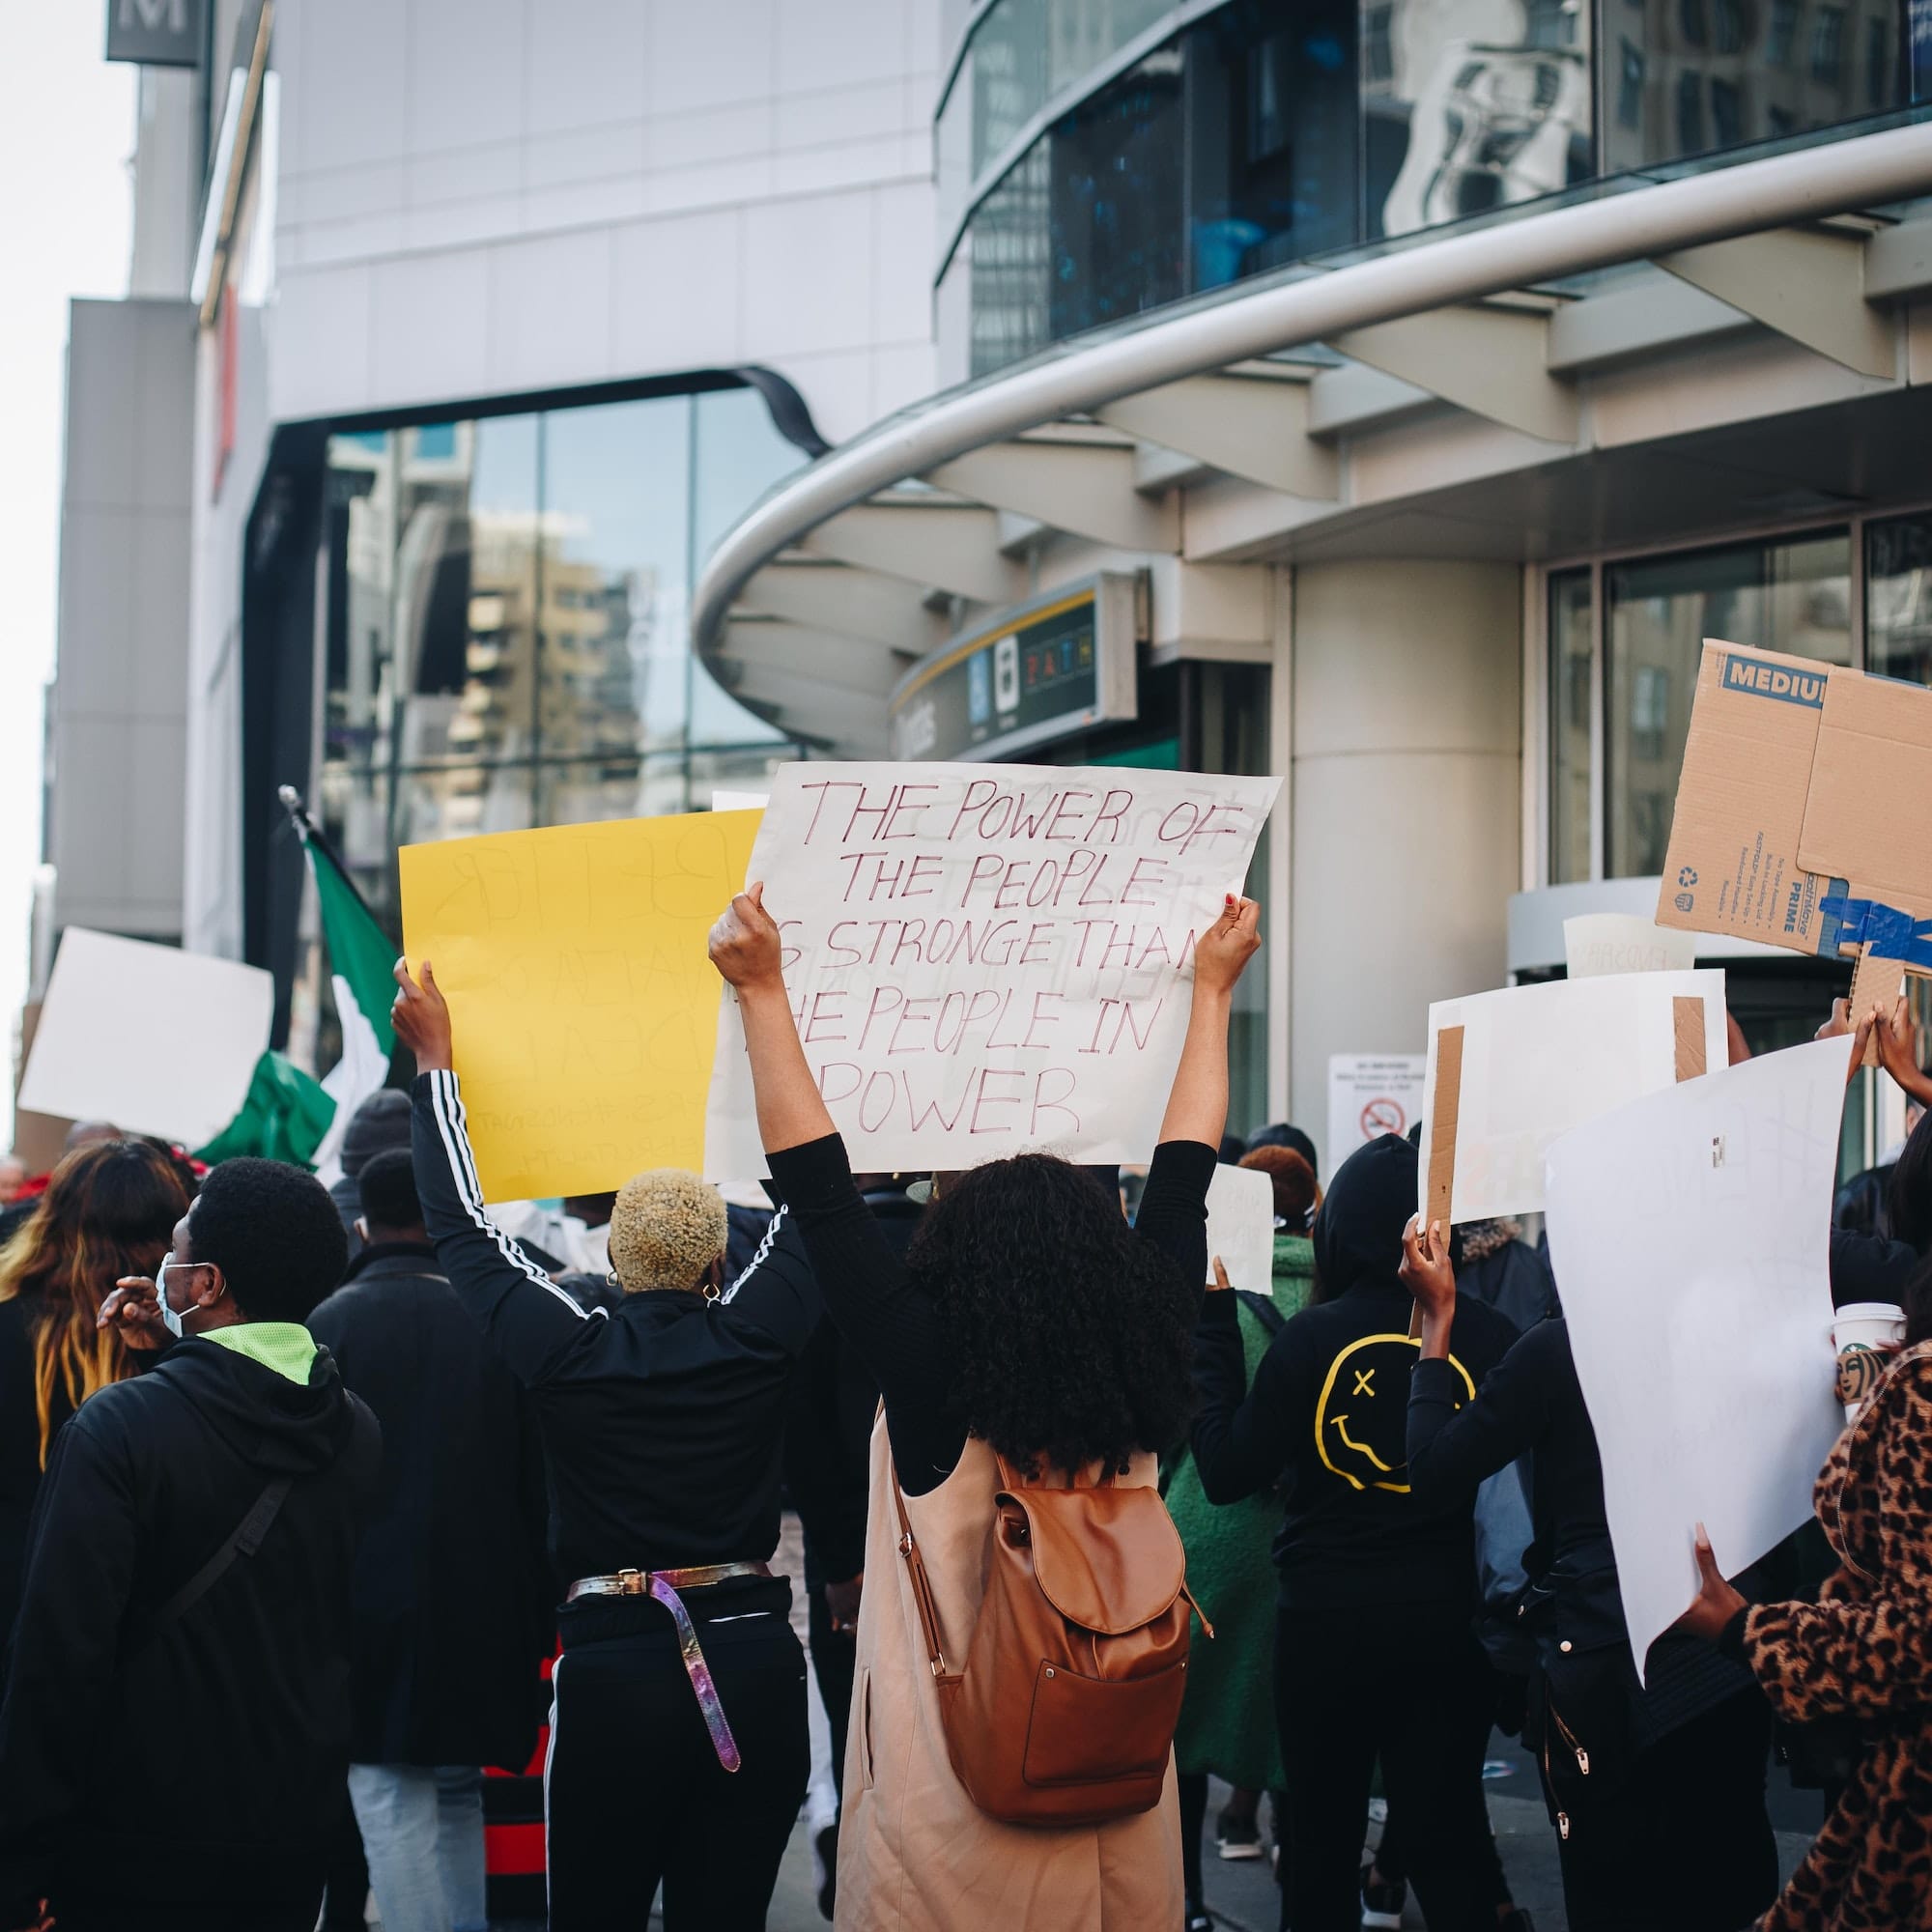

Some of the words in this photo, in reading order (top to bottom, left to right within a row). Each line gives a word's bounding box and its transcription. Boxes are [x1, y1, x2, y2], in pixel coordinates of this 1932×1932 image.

[1730, 662, 1827, 702] MEDIU
[802, 781, 939, 845] THE
[948, 780, 1134, 842] POWER
[1158, 802, 1243, 855] OF
[840, 851, 943, 902] THE
[960, 848, 1168, 909] PEOPLE
[1784, 882, 1802, 933] PRIME
[777, 921, 803, 970] S
[820, 919, 1056, 969] STRONGE
[858, 985, 1064, 1056] PEOPLE
[1078, 997, 1163, 1054] IN
[819, 1063, 1081, 1136] POWER
